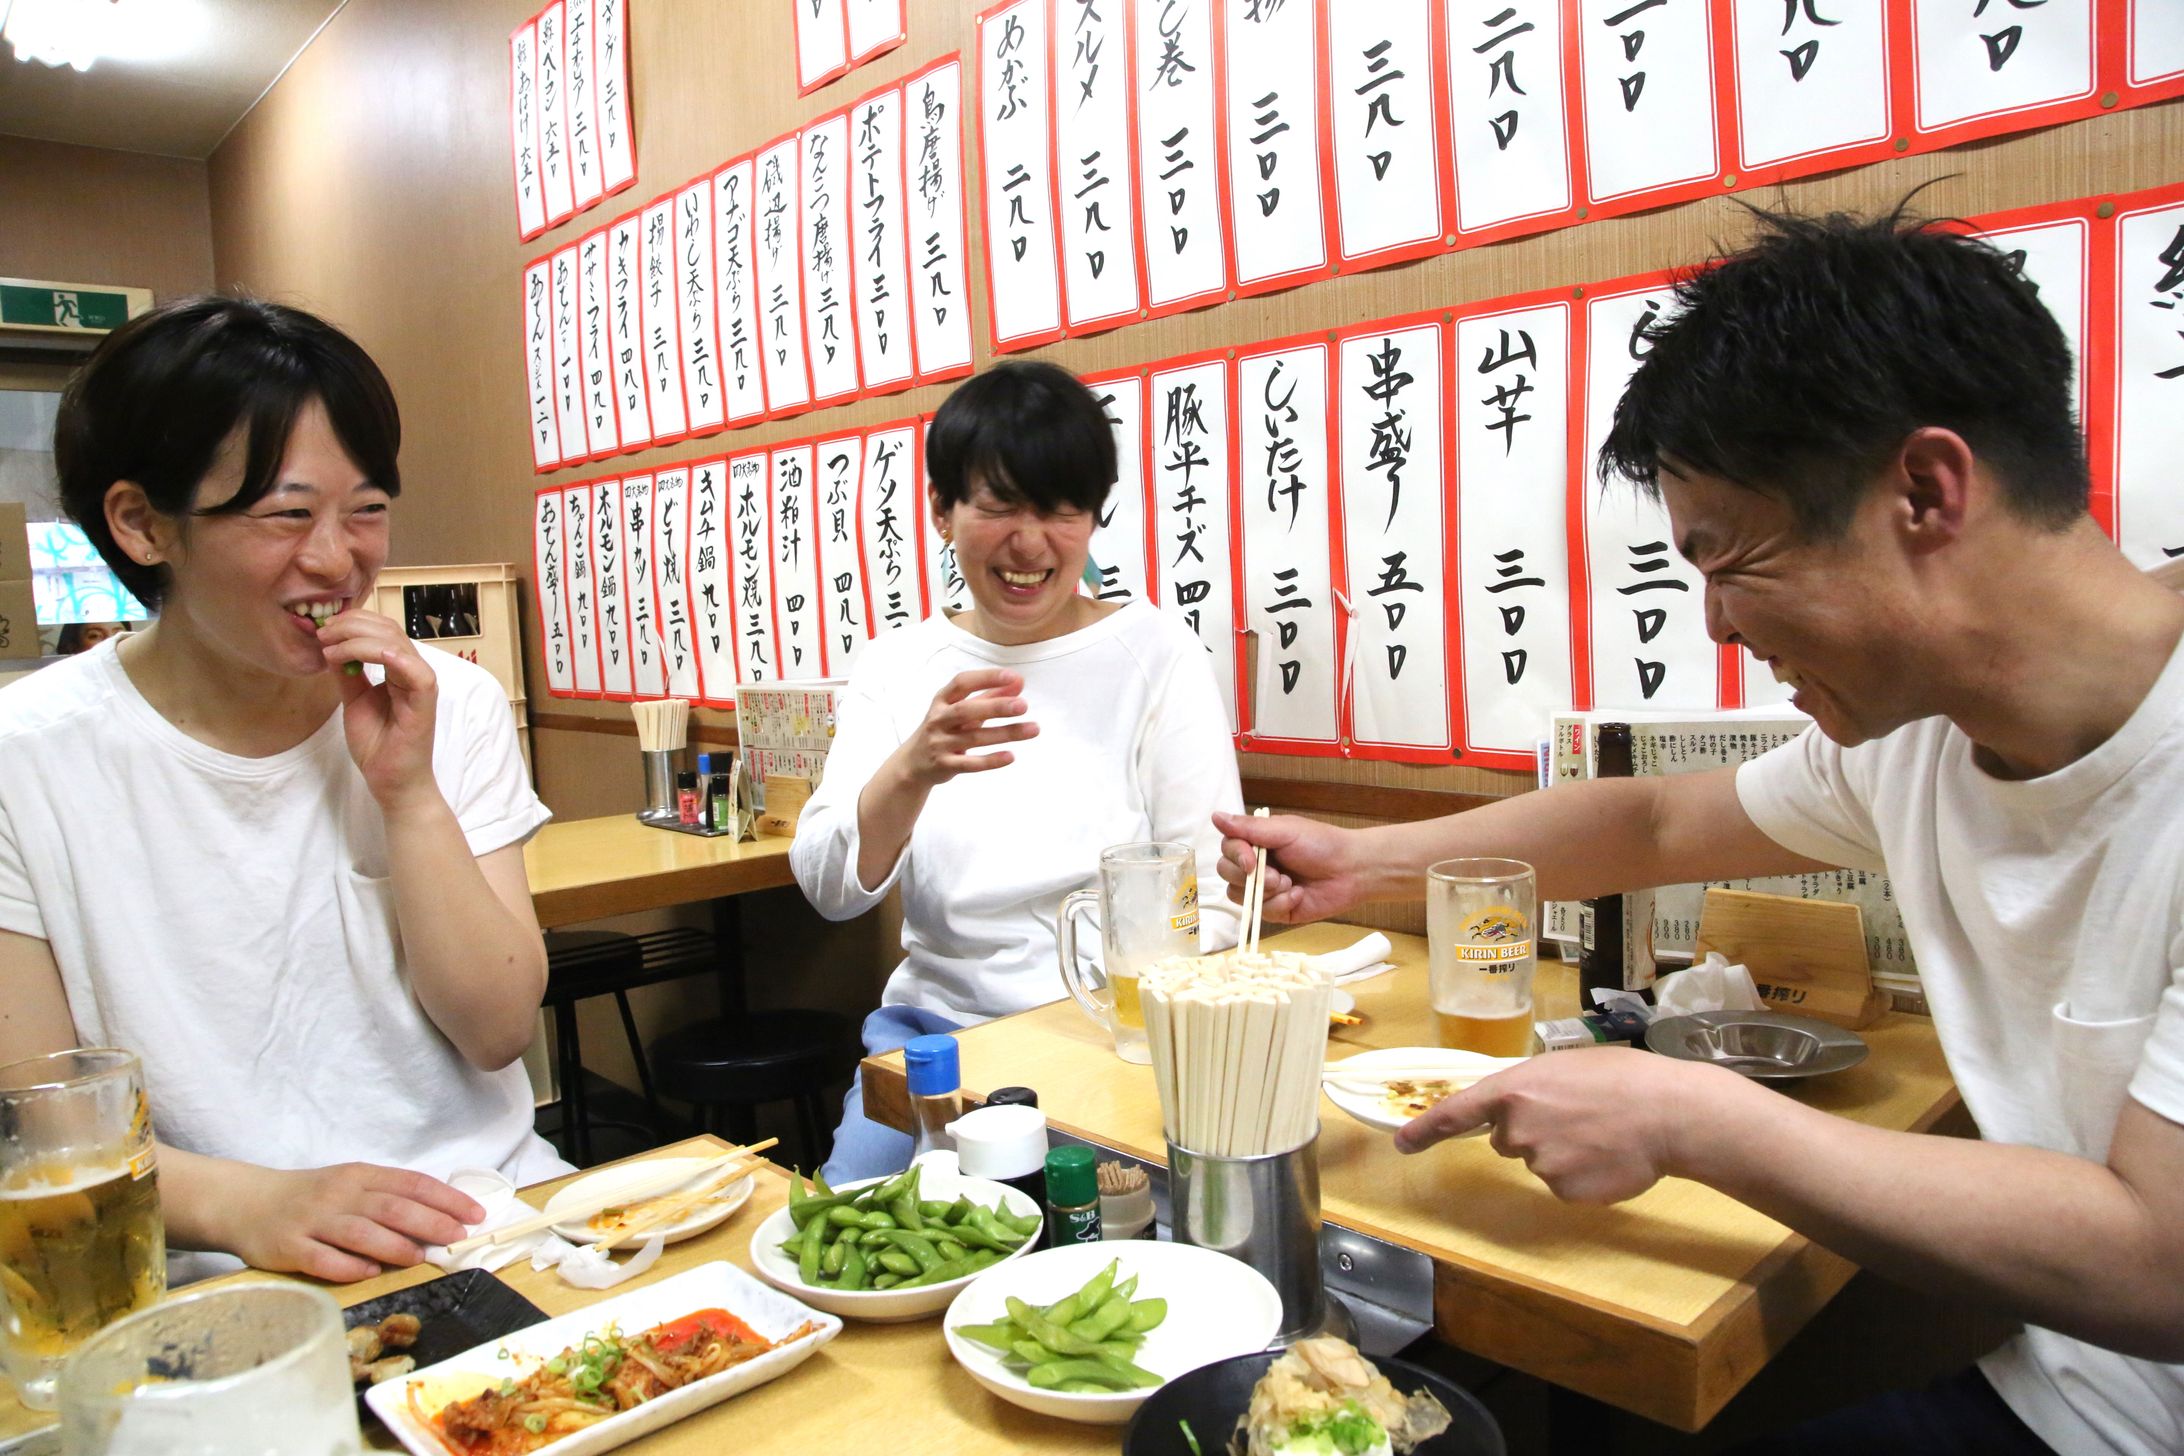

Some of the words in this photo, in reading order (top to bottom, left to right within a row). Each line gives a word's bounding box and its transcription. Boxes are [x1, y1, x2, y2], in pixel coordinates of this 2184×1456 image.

[997, 15, 1027, 120] めかぶ
[859, 105, 884, 267] ポテトフライ
[1362, 338, 1414, 533] 串盛り
[1478, 329, 1536, 456] 山芋
[827, 454, 849, 542] つぶ貝
[1265, 360, 1307, 534] しいたけ
[697, 470, 715, 572] キムチ鍋
[874, 440, 903, 585] ゲソ天ぷら
[1573, 729, 1581, 751] ワイン
[1709, 734, 1717, 755] 竹の子
[1461, 948, 1498, 960] KIRIN
[1501, 945, 1527, 958] BEER
[1479, 963, 1515, 974] 一番搾り
[1069, 1210, 1096, 1223] S&B
